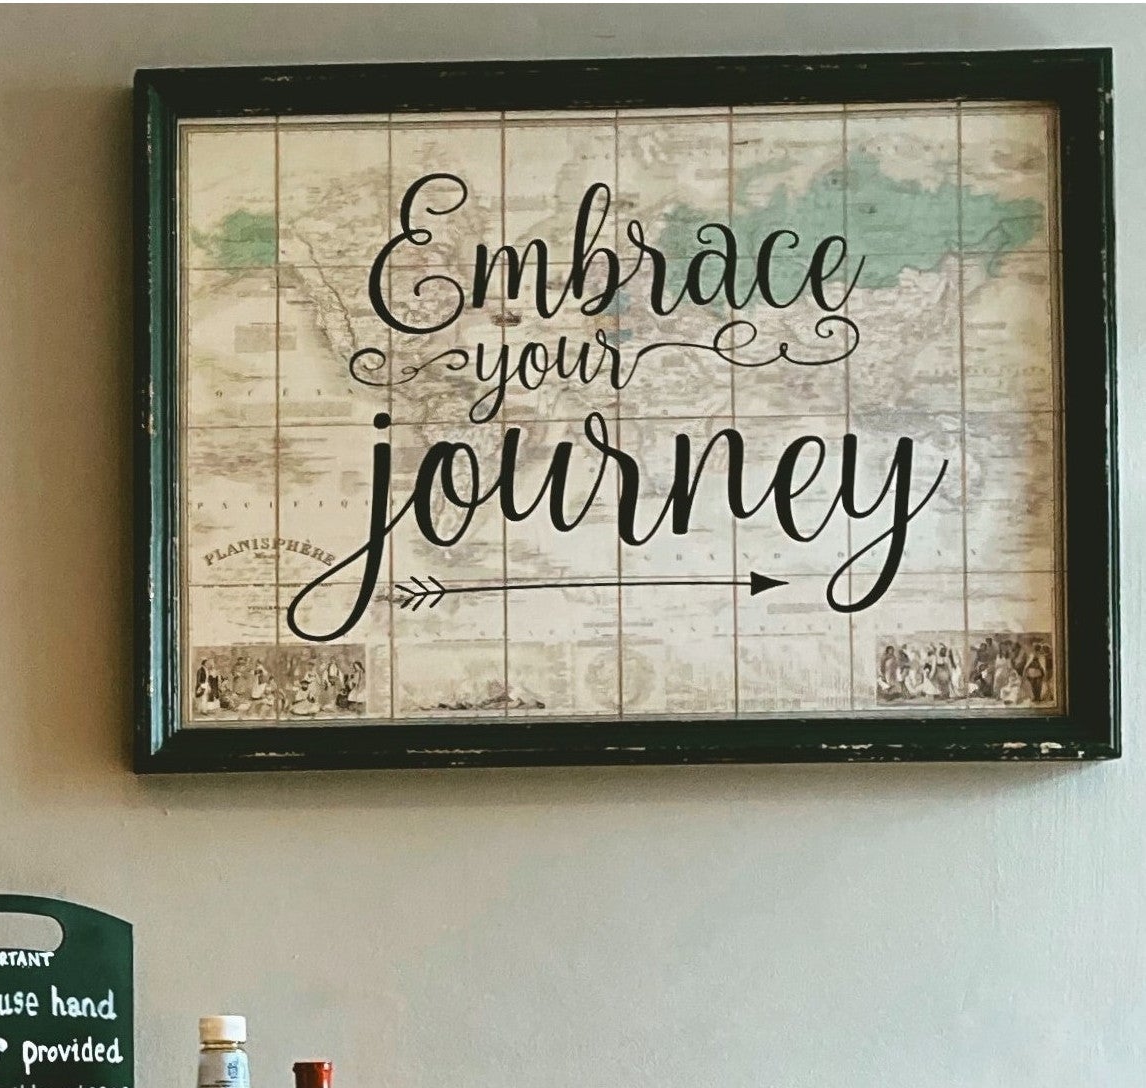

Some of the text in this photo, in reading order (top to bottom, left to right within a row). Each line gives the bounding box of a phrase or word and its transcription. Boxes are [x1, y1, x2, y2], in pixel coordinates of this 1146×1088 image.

[369, 173, 866, 334] Embrace
[468, 328, 640, 424] your
[204, 538, 337, 567] PLANISPHÈRE
[286, 412, 949, 641] journey
[51, 986, 118, 1021] hand
[22, 1036, 124, 1075] provided
